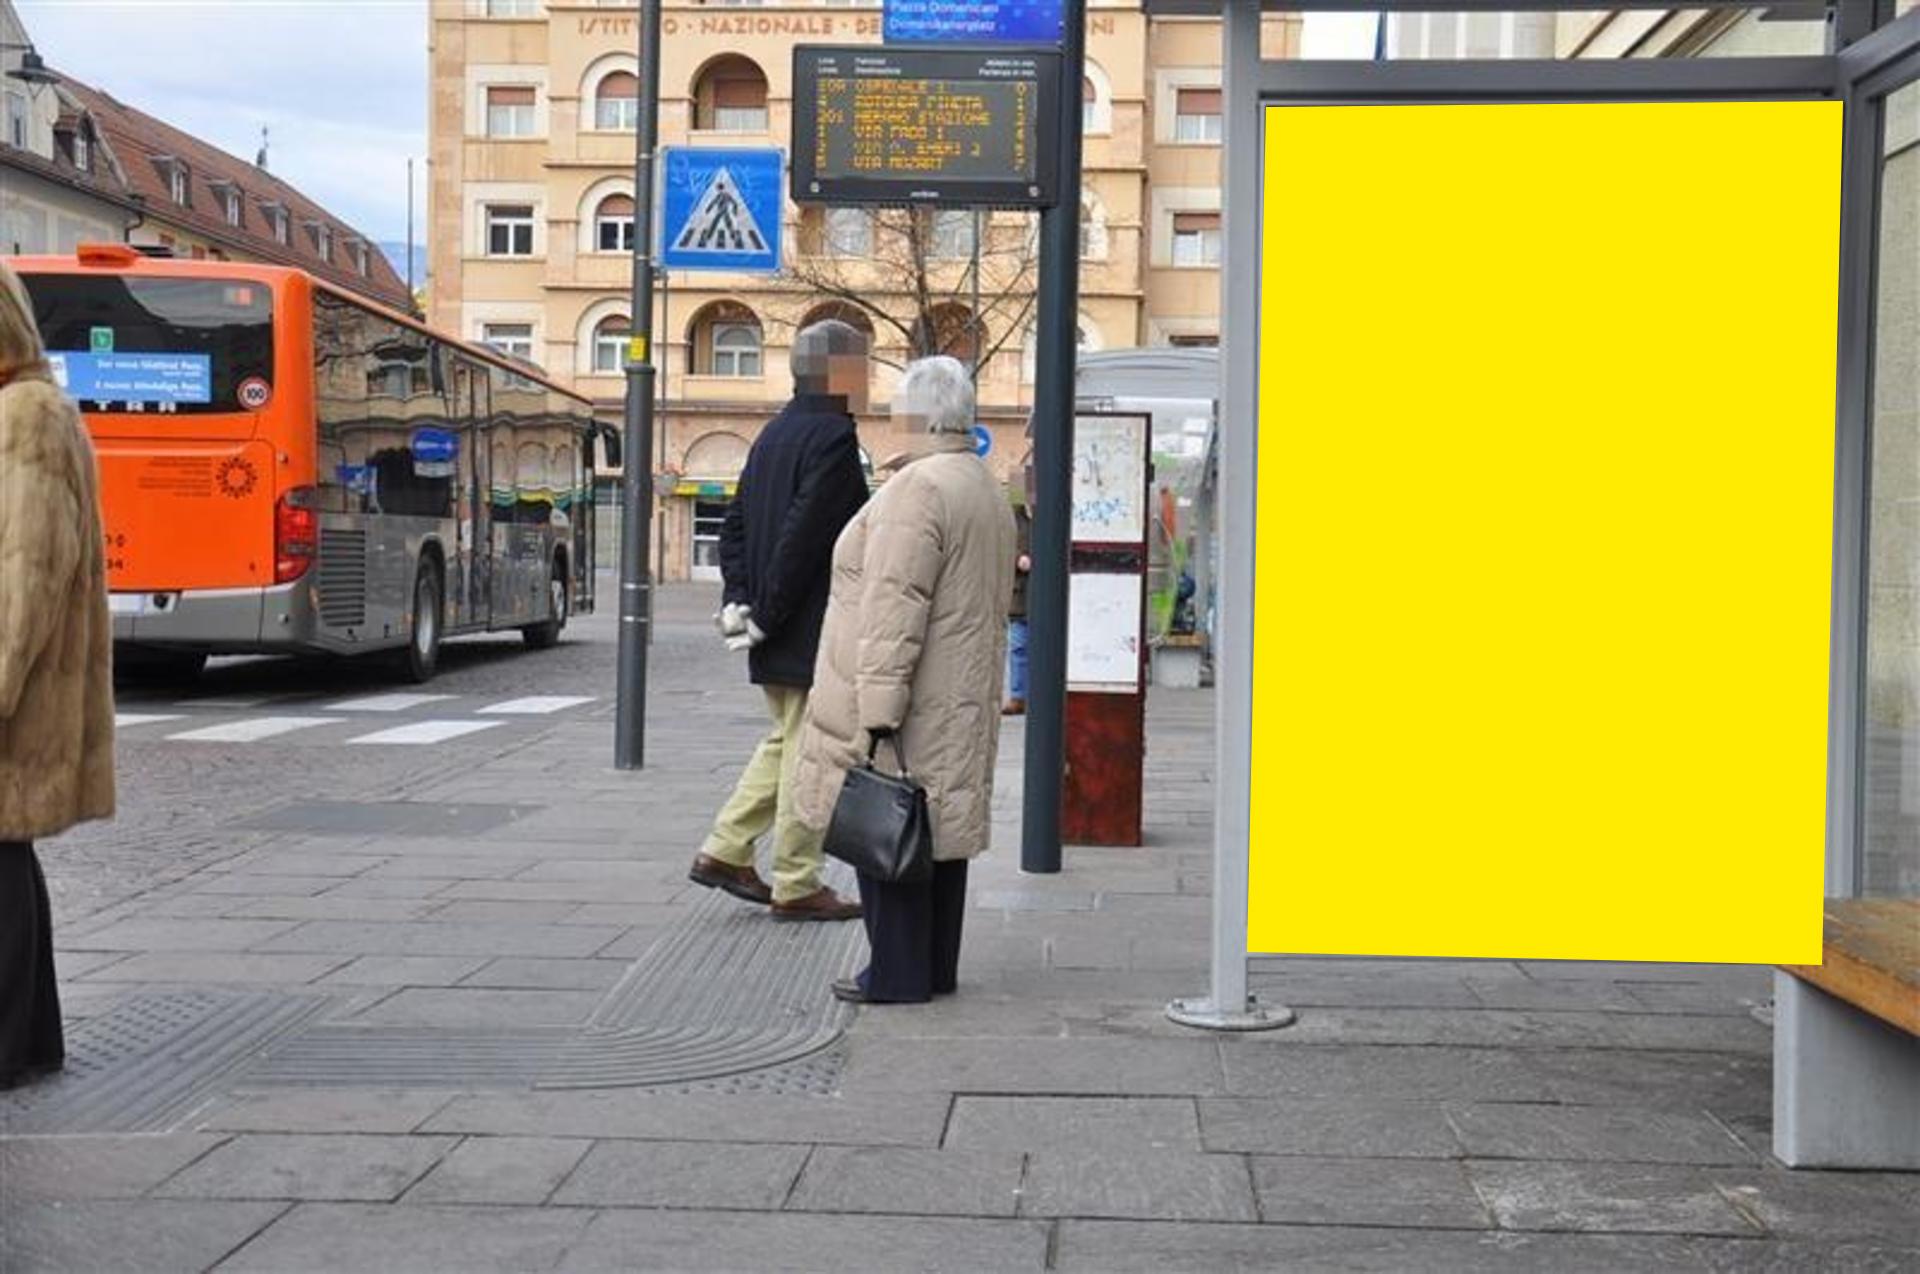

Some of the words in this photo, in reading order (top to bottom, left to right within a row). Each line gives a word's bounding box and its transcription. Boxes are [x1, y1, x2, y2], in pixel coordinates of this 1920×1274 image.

[578, 16, 678, 35] ISTITO
[700, 16, 834, 35] NAZIONALE
[245, 387, 265, 400] 100
